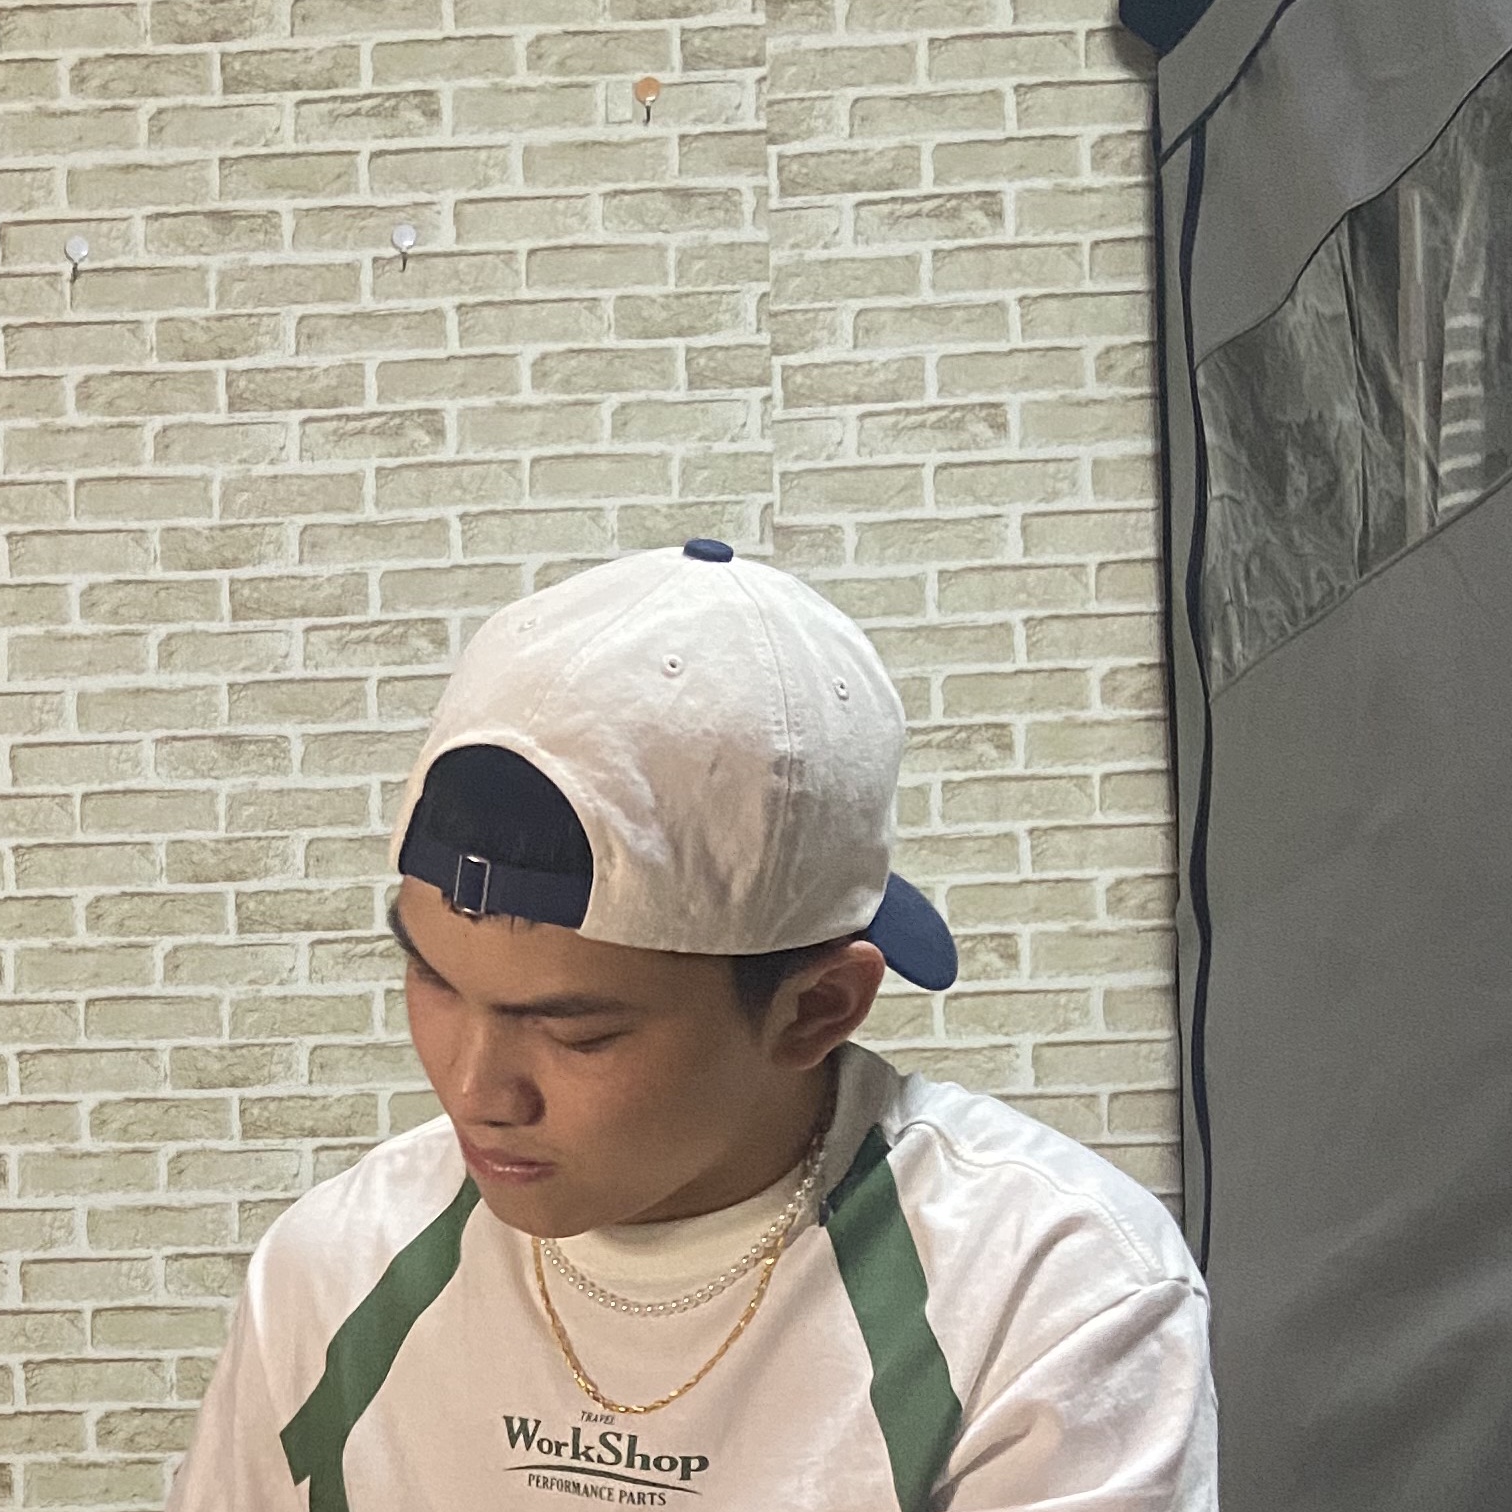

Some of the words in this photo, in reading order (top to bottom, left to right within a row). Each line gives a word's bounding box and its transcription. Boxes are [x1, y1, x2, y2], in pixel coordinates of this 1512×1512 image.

[581, 1410, 615, 1425] TRAVEL
[503, 1415, 709, 1481] WorkShop
[528, 1473, 614, 1502] PERFORMANCE
[618, 1489, 666, 1506] PARTS
